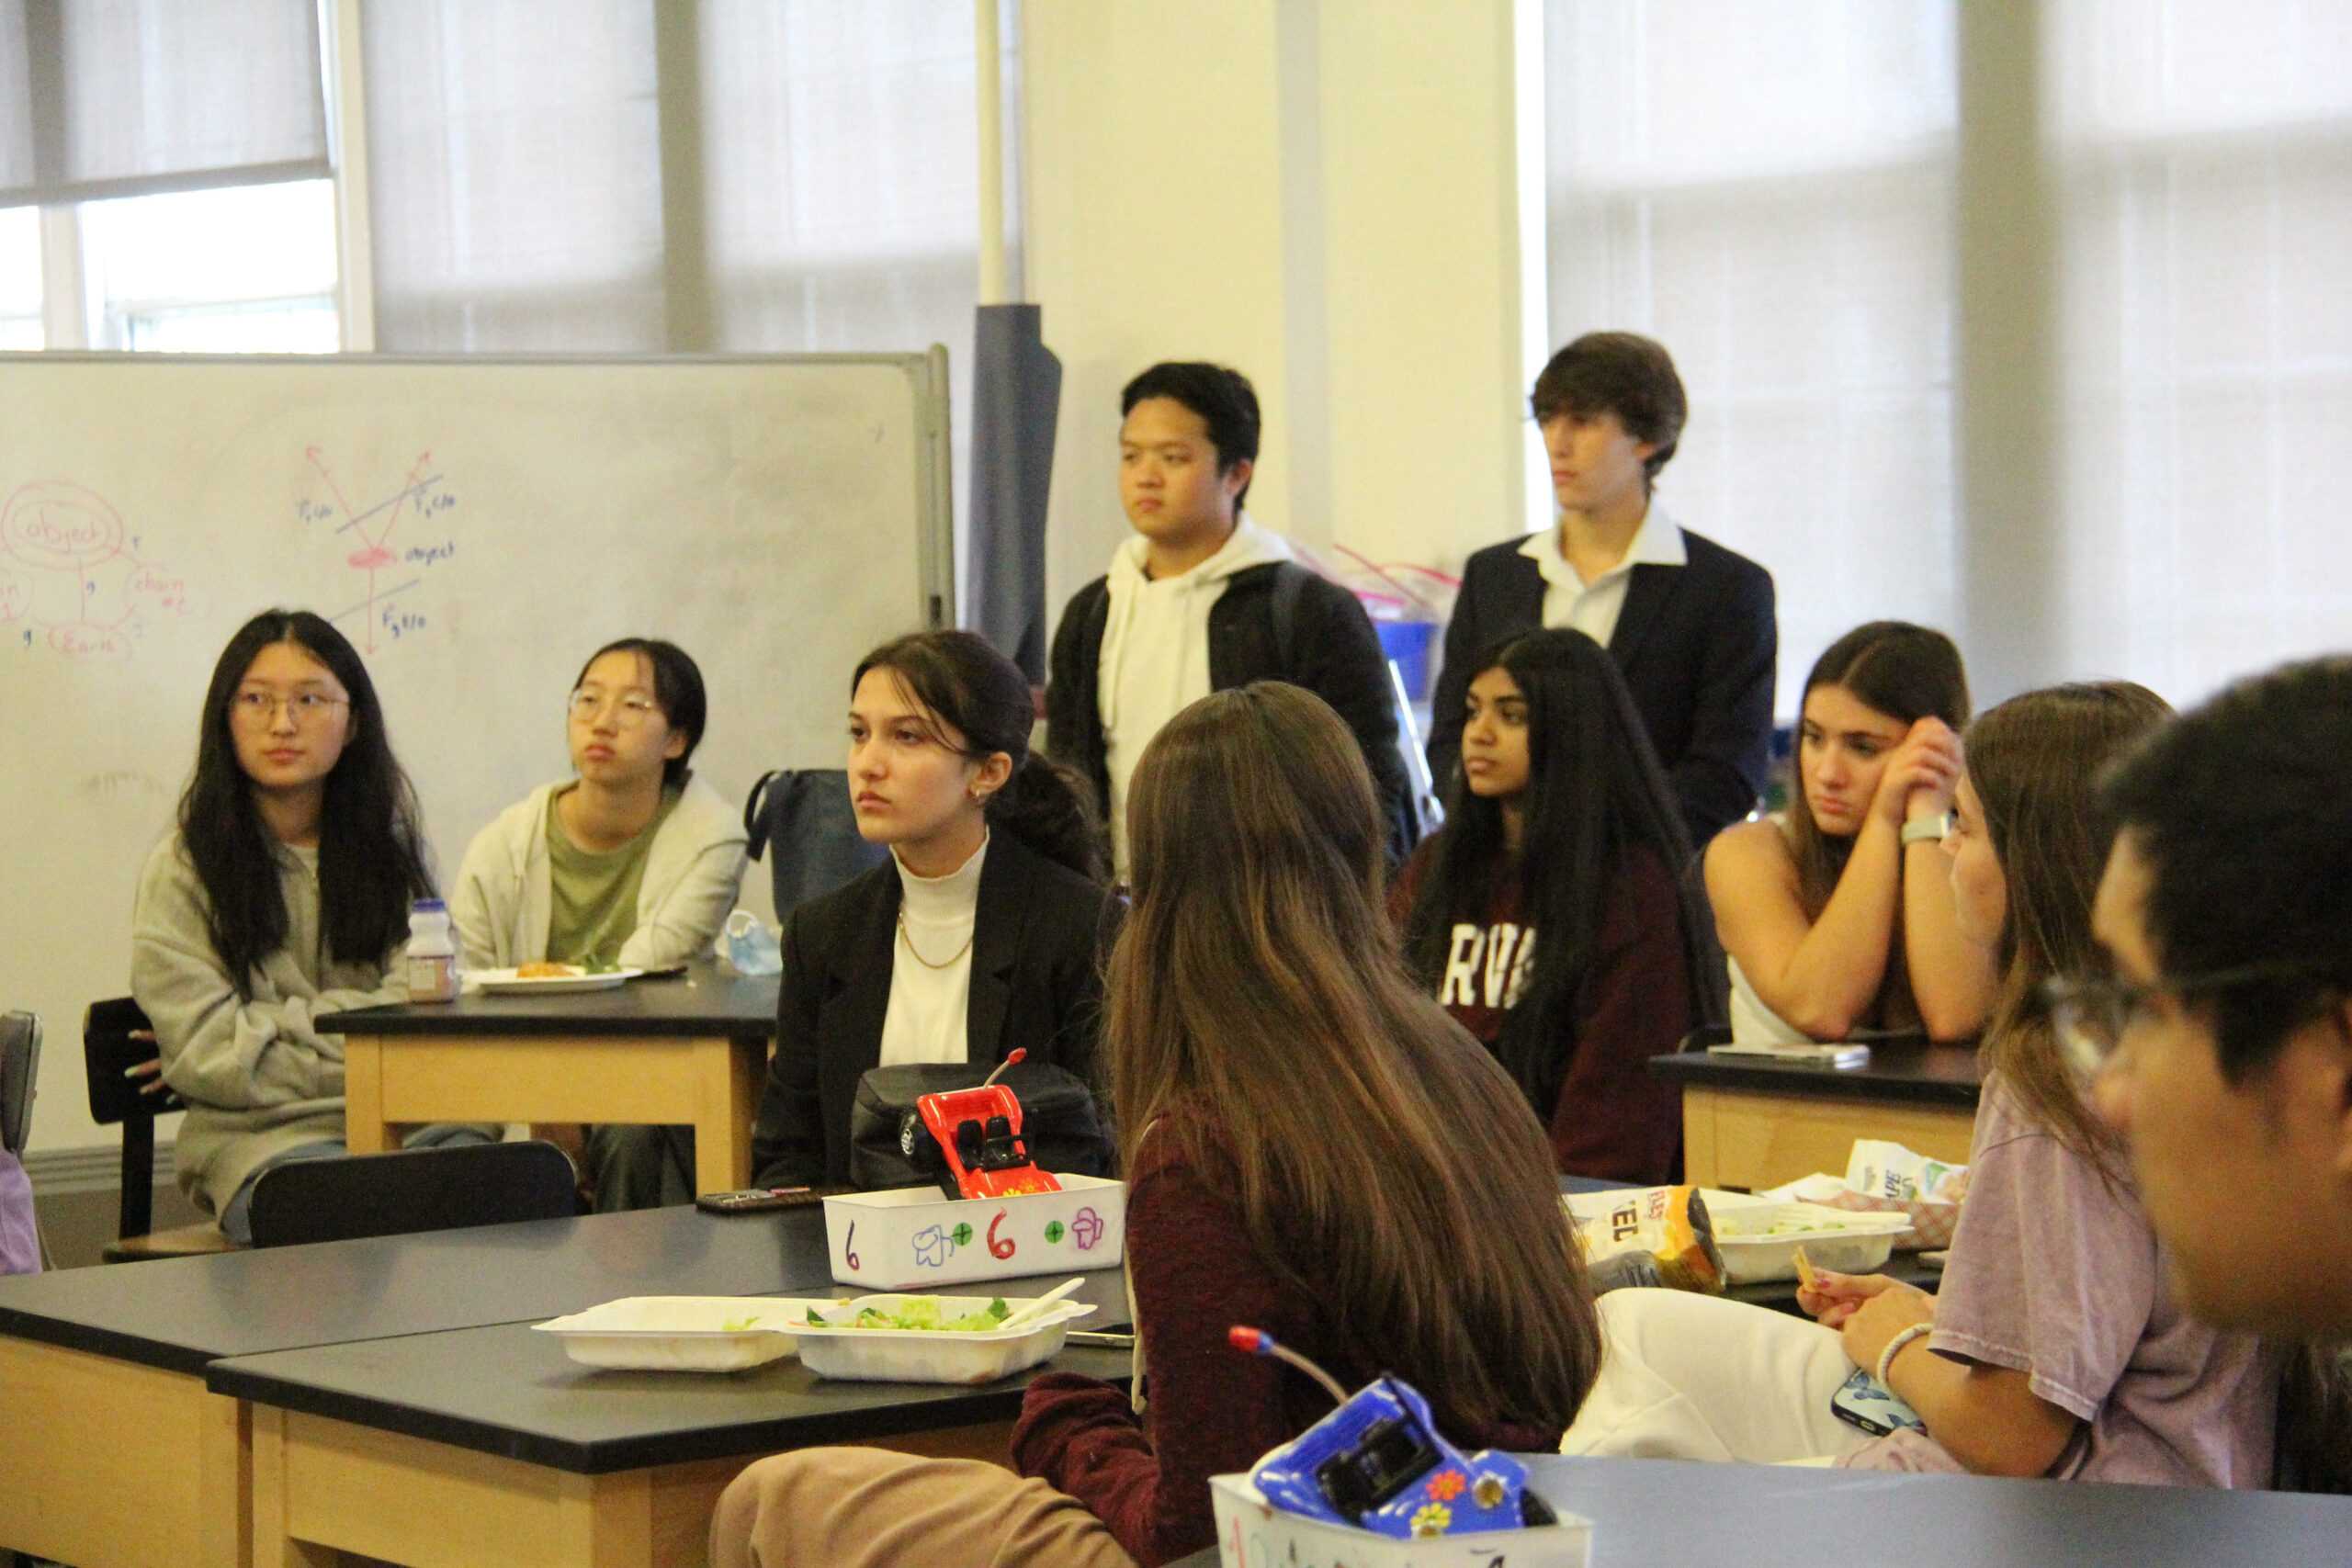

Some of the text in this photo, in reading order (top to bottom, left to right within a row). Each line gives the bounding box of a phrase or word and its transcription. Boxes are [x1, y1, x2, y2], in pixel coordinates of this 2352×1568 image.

[28, 506, 99, 553] object
[846, 1219, 860, 1271] 6
[987, 1207, 1016, 1260] 6
